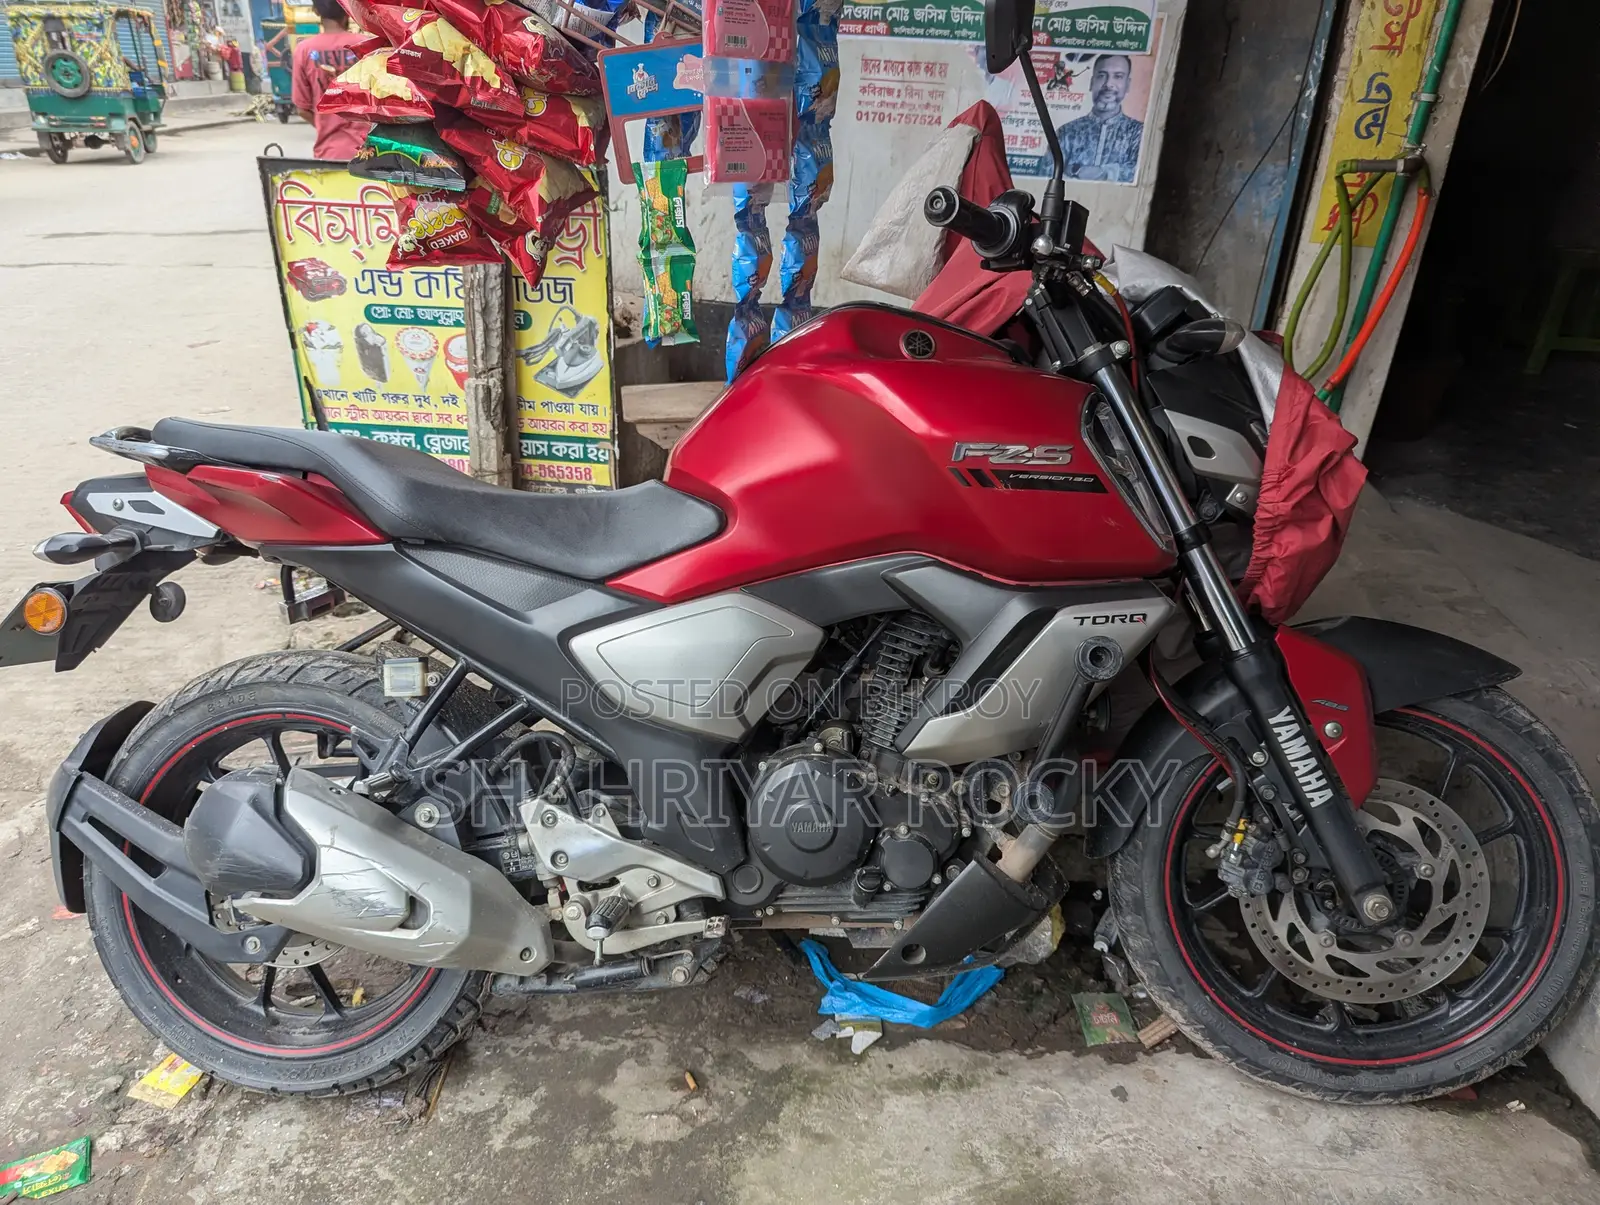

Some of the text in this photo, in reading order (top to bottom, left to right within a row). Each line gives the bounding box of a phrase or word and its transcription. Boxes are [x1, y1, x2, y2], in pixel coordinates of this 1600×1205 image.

[886, 5, 909, 21] মোঃ
[913, 4, 947, 24] জসিম
[950, 5, 985, 26] উদ্দিন
[1047, 17, 1071, 33] মোঃ
[1075, 14, 1110, 34] জসিম
[1113, 16, 1148, 36] উদ্দিন
[430, 230, 469, 250] BAKED
[354, 268, 406, 299] এন্ড
[441, 393, 460, 408] দই
[540, 400, 575, 415] পাওয়া
[372, 408, 410, 424] আয়রন
[436, 413, 453, 425] সব
[527, 418, 566, 432] আয়রন
[568, 421, 589, 434] করা
[591, 421, 608, 436] হয়
[550, 441, 585, 460] করা
[1072, 612, 1149, 626] TORQ
[1267, 705, 1334, 809] YAMAHA
[790, 820, 833, 833] YAMAHA
